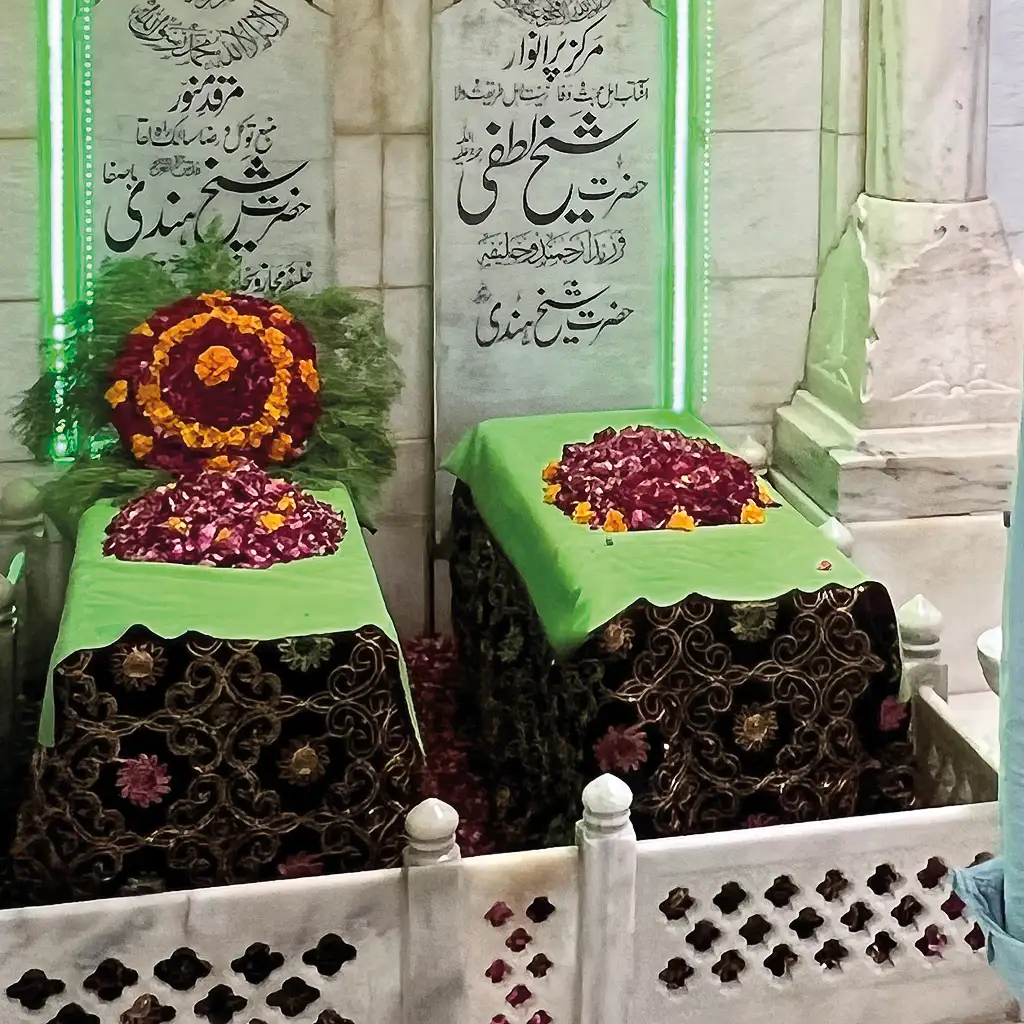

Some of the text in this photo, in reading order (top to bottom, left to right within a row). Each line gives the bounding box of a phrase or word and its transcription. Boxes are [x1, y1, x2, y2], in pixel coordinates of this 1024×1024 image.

[502, 30, 550, 71] انوار
[563, 13, 608, 73] مرکز
[457, 110, 649, 226] حضرت شیخ لطفی
[104, 154, 312, 254] حضرت شیخ ہندی
[475, 301, 534, 349] ہندی
[533, 279, 612, 349] شیخ
[566, 300, 635, 347] حضرت
